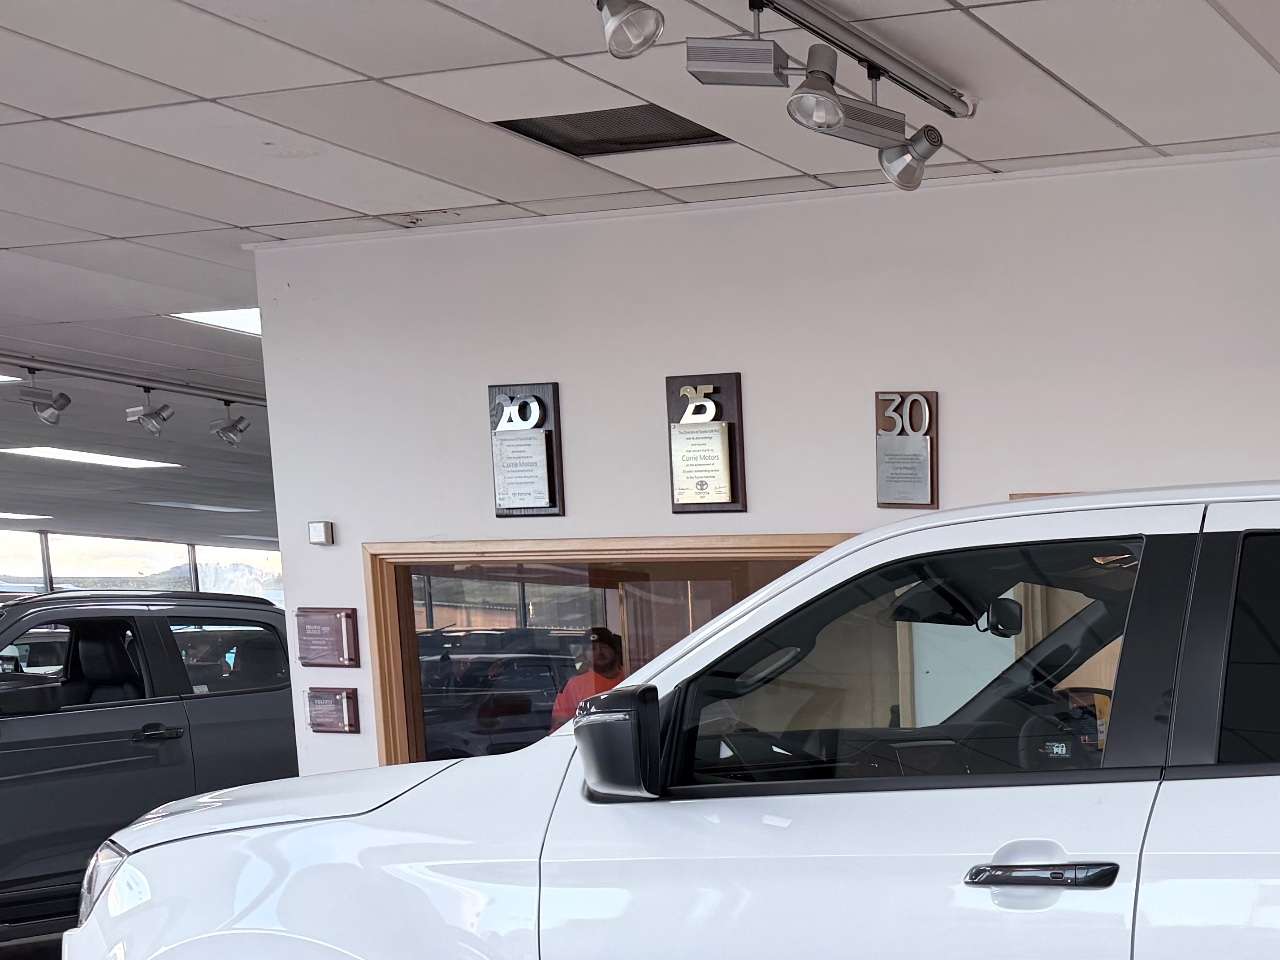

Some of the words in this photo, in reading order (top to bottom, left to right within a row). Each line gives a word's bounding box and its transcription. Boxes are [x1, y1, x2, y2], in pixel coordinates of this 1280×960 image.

[496, 394, 540, 431] 20
[679, 385, 717, 424] 25
[878, 393, 929, 436] 30
